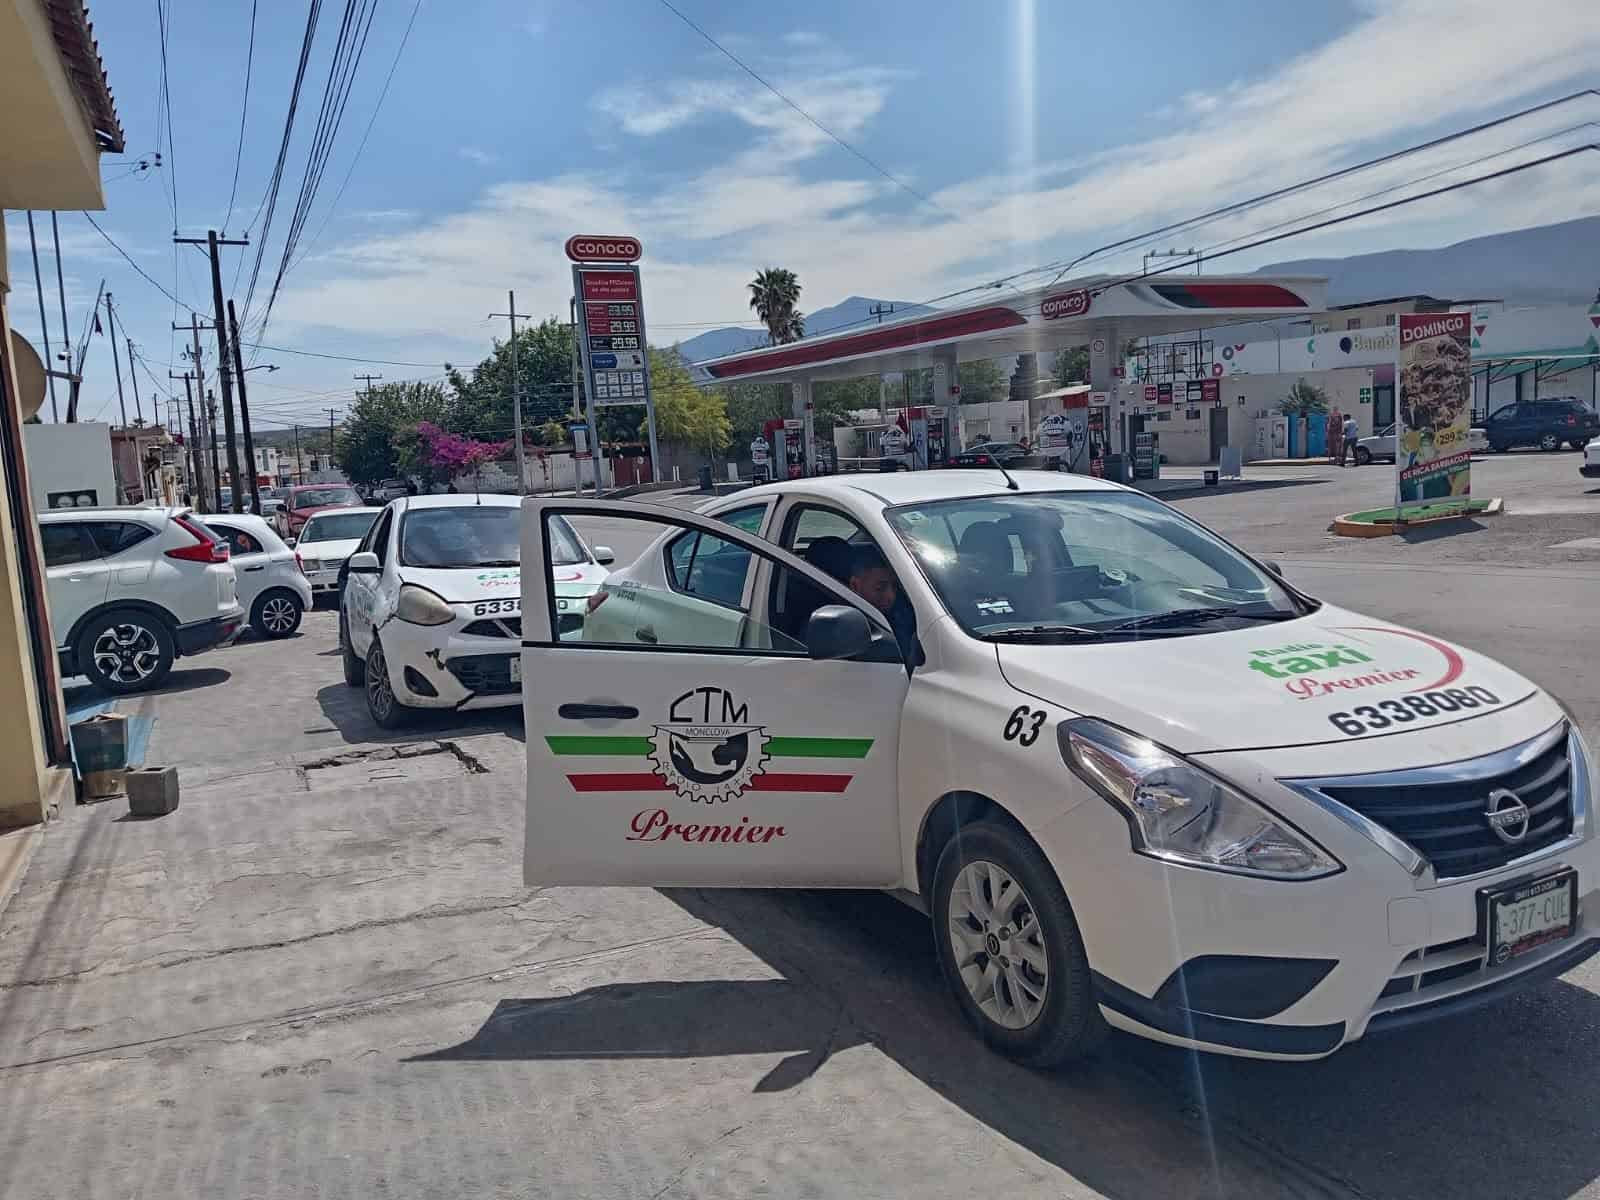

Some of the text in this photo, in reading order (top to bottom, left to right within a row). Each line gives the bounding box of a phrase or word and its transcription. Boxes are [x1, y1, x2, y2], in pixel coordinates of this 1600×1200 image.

[576, 243, 635, 254] conoco
[1402, 317, 1465, 342] DOMINGO
[1248, 644, 1374, 678] taxi
[1285, 668, 1422, 700] Premier
[669, 686, 748, 723] CTM
[1328, 685, 1501, 736] 6338080
[685, 727, 730, 737] MONCLOVA
[1004, 705, 1047, 747] 63
[662, 761, 753, 793] RADIO TAXIS
[626, 808, 788, 844] Premier
